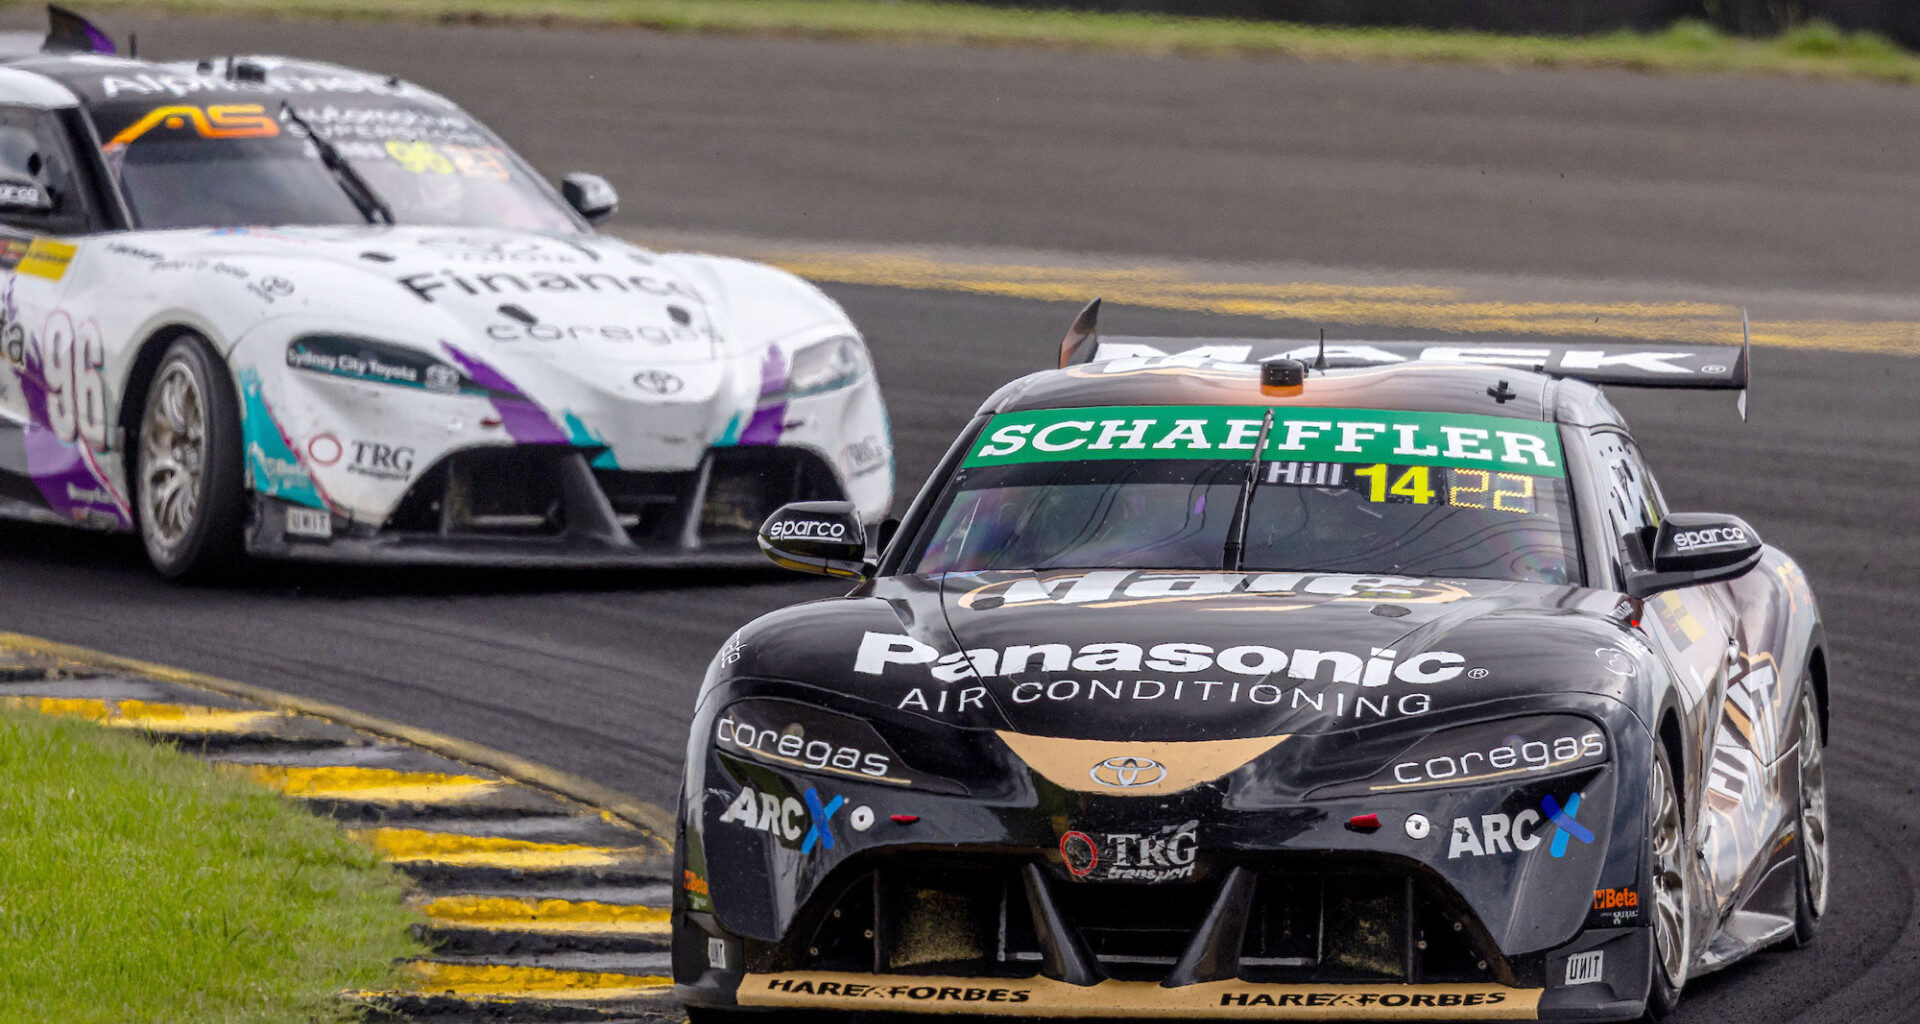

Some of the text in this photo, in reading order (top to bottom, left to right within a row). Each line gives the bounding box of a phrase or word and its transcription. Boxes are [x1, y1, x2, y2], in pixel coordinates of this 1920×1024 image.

[101, 104, 279, 152] AS
[43, 310, 104, 453] 96
[288, 349, 417, 381] Sydney City Toyota
[352, 439, 416, 472] TRG
[977, 419, 1556, 467] SCHAEFFLER
[1267, 461, 1435, 505] Hill 14
[1450, 467, 1534, 514] 22
[770, 520, 845, 541] sparco
[1673, 526, 1745, 550] sparco
[853, 631, 1467, 688] Panasonic
[898, 679, 1431, 718] AIR CONDITIONING
[718, 717, 890, 777] coregas
[1394, 732, 1604, 783] coregas
[1106, 831, 1199, 867] TRG
[1605, 888, 1638, 909] Beta
[1568, 955, 1600, 980] UNIT
